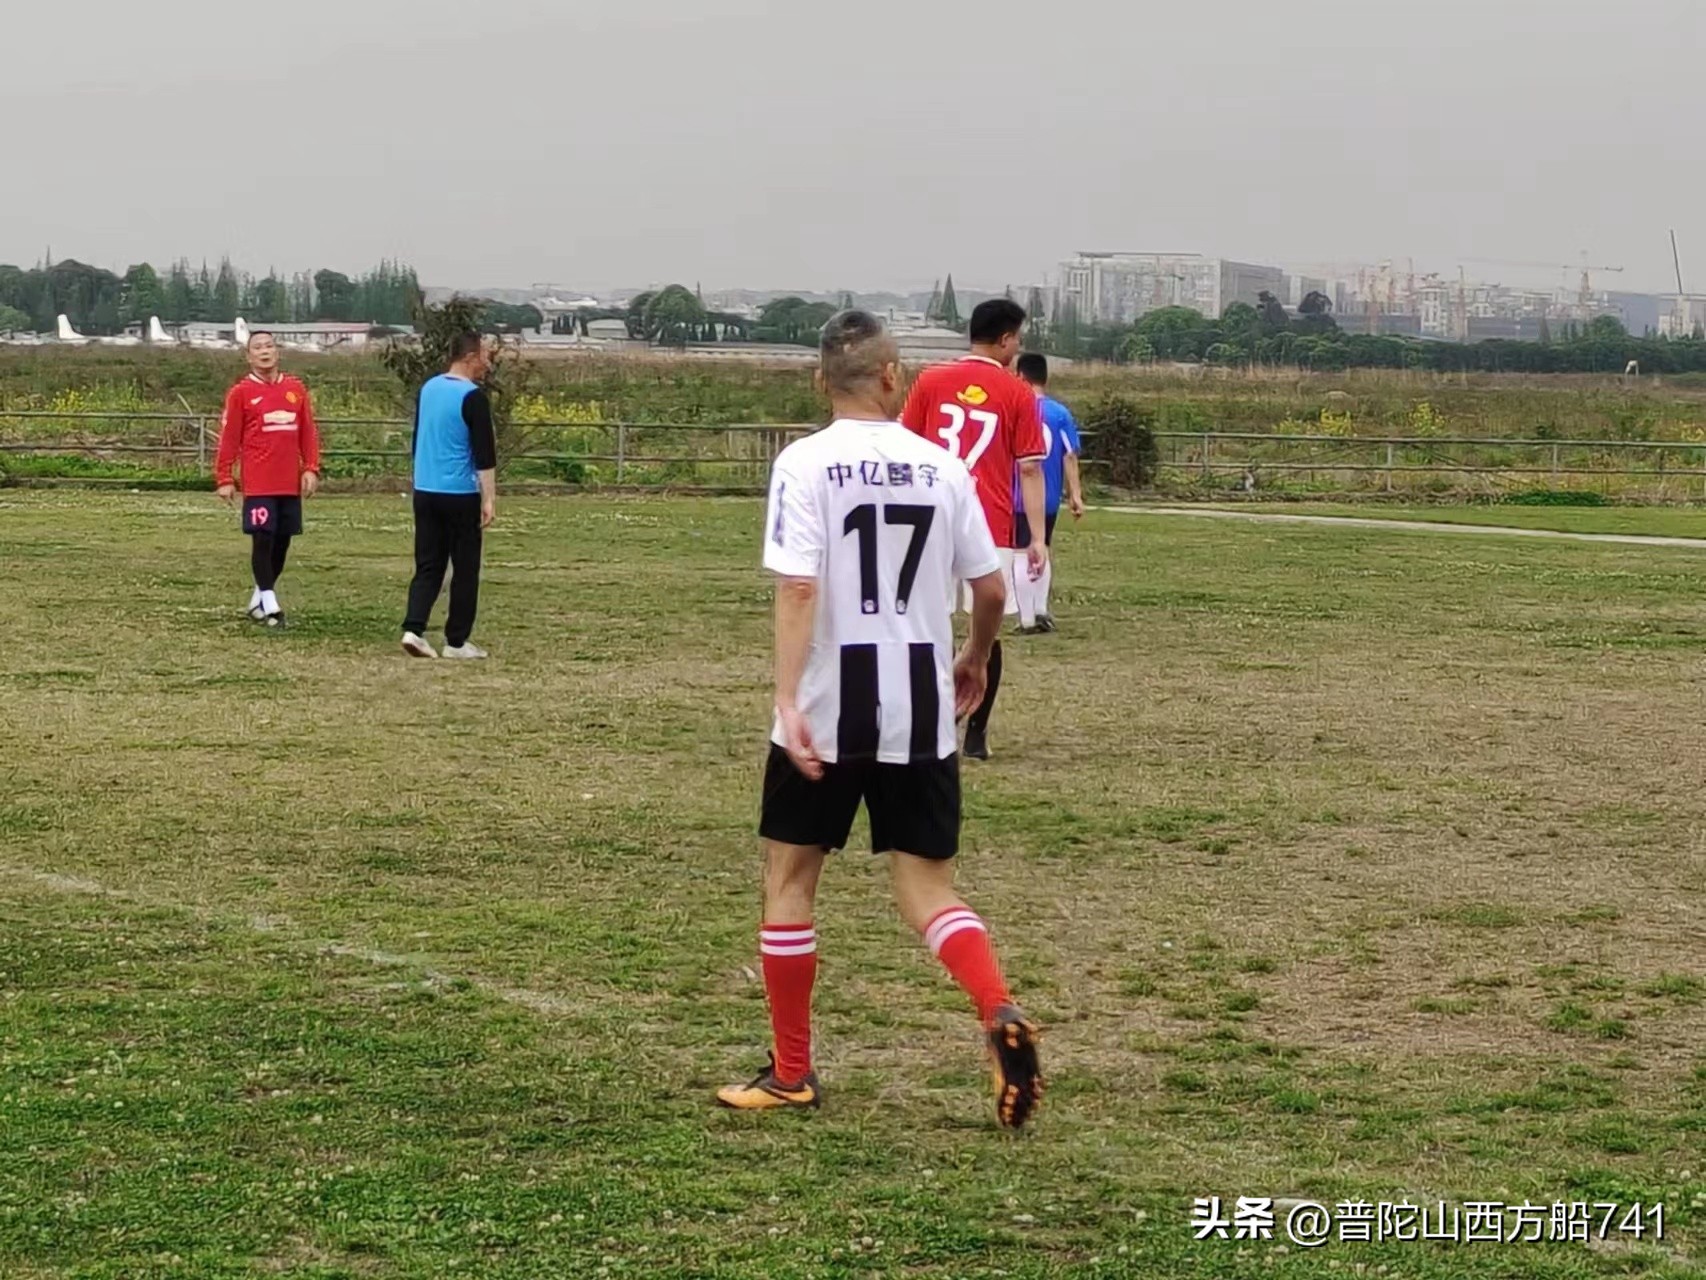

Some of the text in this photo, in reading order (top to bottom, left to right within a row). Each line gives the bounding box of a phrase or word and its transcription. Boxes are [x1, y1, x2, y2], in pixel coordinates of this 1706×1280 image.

[938, 403, 998, 468] 37
[250, 506, 269, 526] 19
[842, 504, 936, 615] 17
